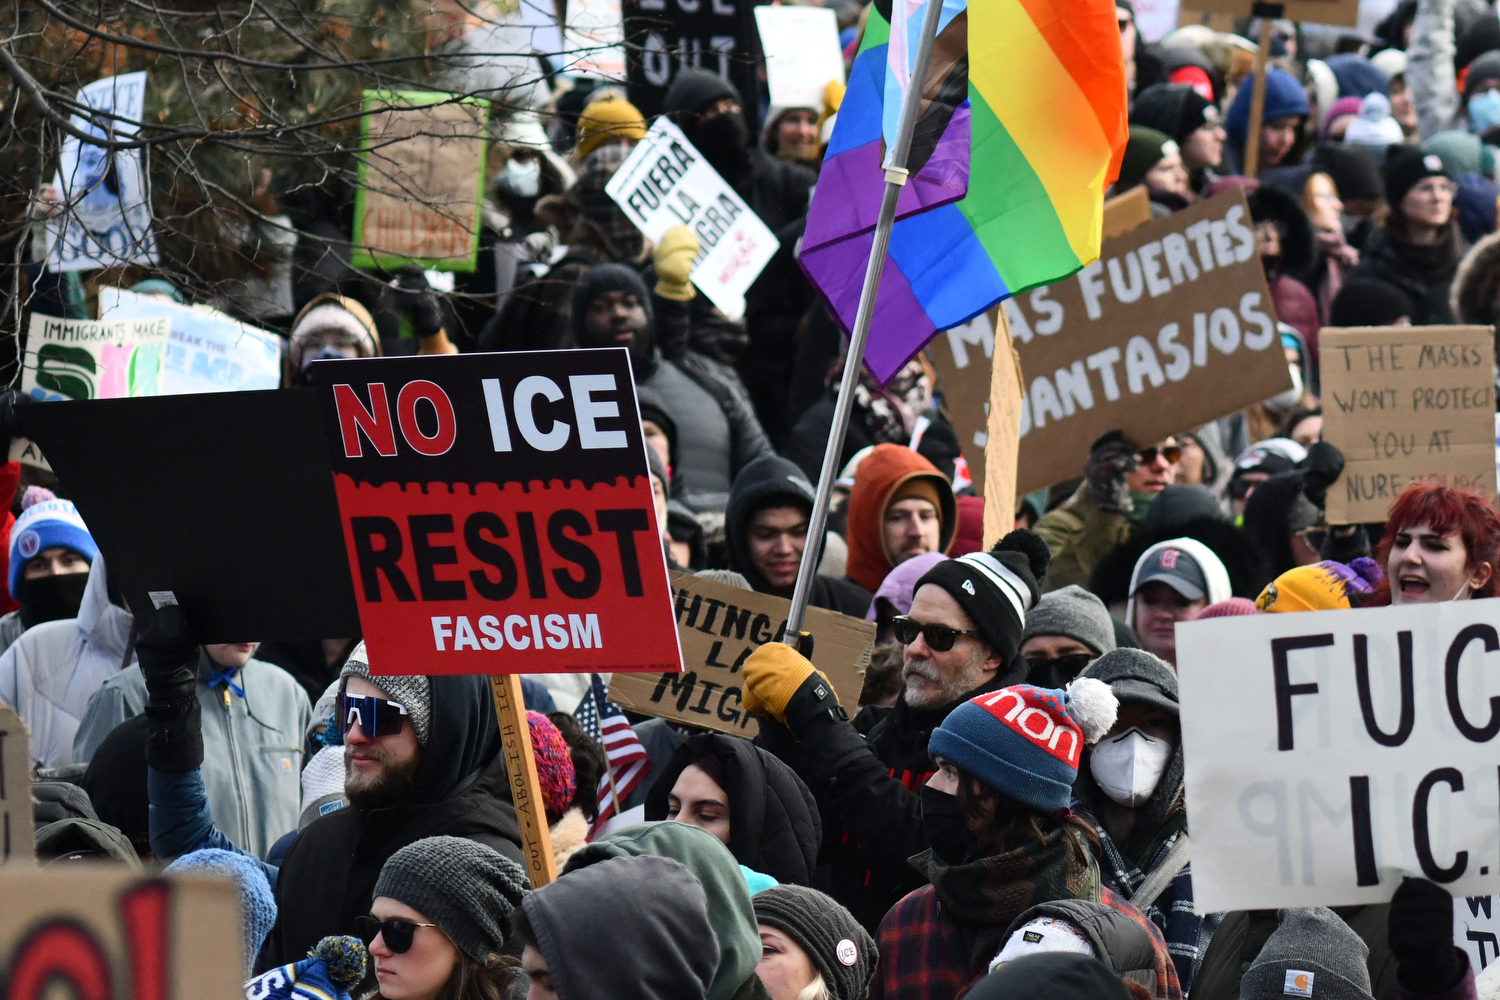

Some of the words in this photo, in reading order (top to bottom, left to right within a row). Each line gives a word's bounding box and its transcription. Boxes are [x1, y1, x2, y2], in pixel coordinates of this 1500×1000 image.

[627, 141, 696, 224] FUERA
[666, 190, 702, 226] LA
[1077, 205, 1255, 320] FUERTES
[43, 320, 126, 342] IMMIGRANTS
[131, 319, 167, 337] MAKE
[1335, 344, 1404, 372] THE
[1418, 344, 1482, 370] MASKS
[333, 380, 456, 458] NO
[481, 374, 628, 452] ICE
[1333, 387, 1397, 413] WON'T
[1413, 386, 1490, 412] PROTECT
[1368, 430, 1416, 458] YOU
[1428, 430, 1453, 455] AT
[350, 509, 650, 603] RESIST
[431, 613, 603, 651] FASCISM
[675, 588, 790, 646] HING
[494, 674, 511, 714] ICE
[650, 671, 757, 729] MIG
[503, 724, 531, 815] ABOLISH
